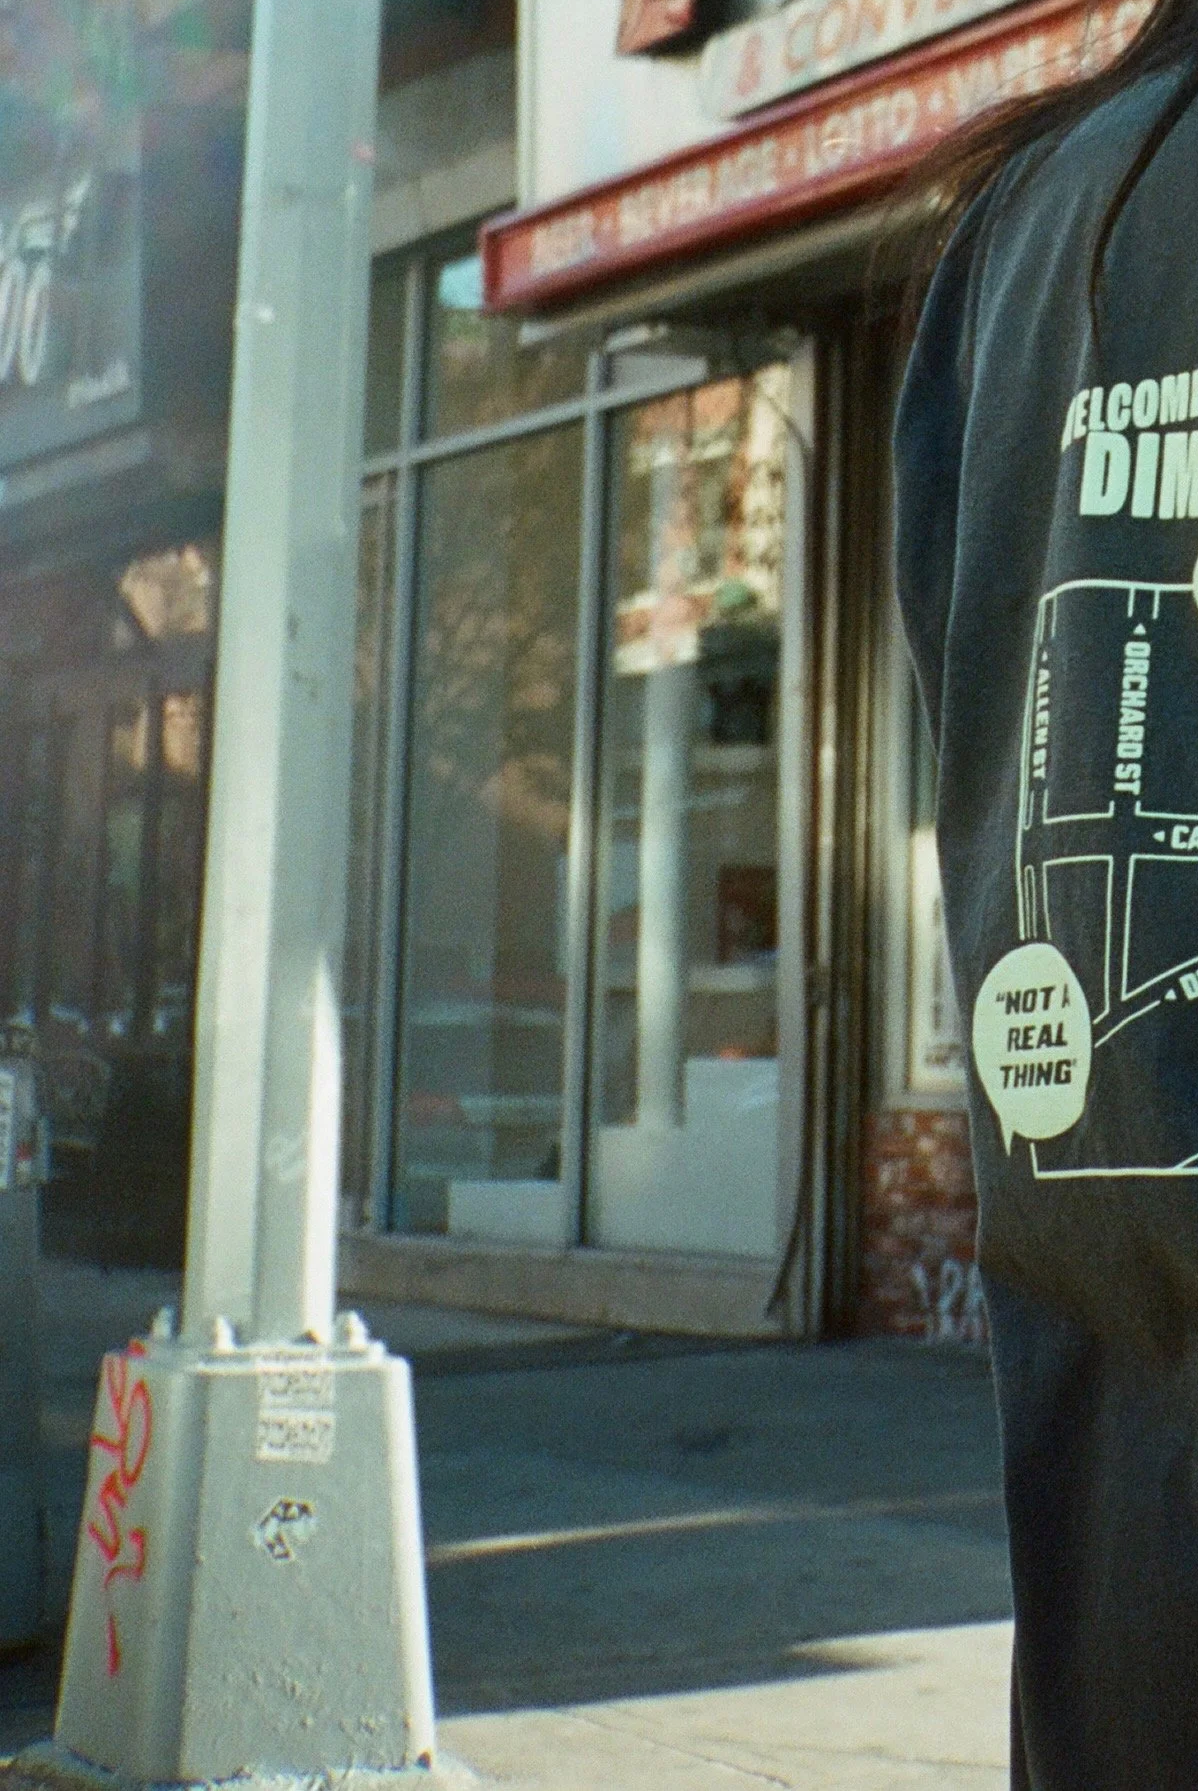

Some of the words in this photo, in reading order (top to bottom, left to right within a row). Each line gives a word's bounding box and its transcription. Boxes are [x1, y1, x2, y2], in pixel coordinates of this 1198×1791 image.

[1034, 667, 1050, 746] ALLEN
[1116, 641, 1151, 759] ORCHARD
[1113, 762, 1142, 796] ST
[1007, 1021, 1068, 1053] REAL
